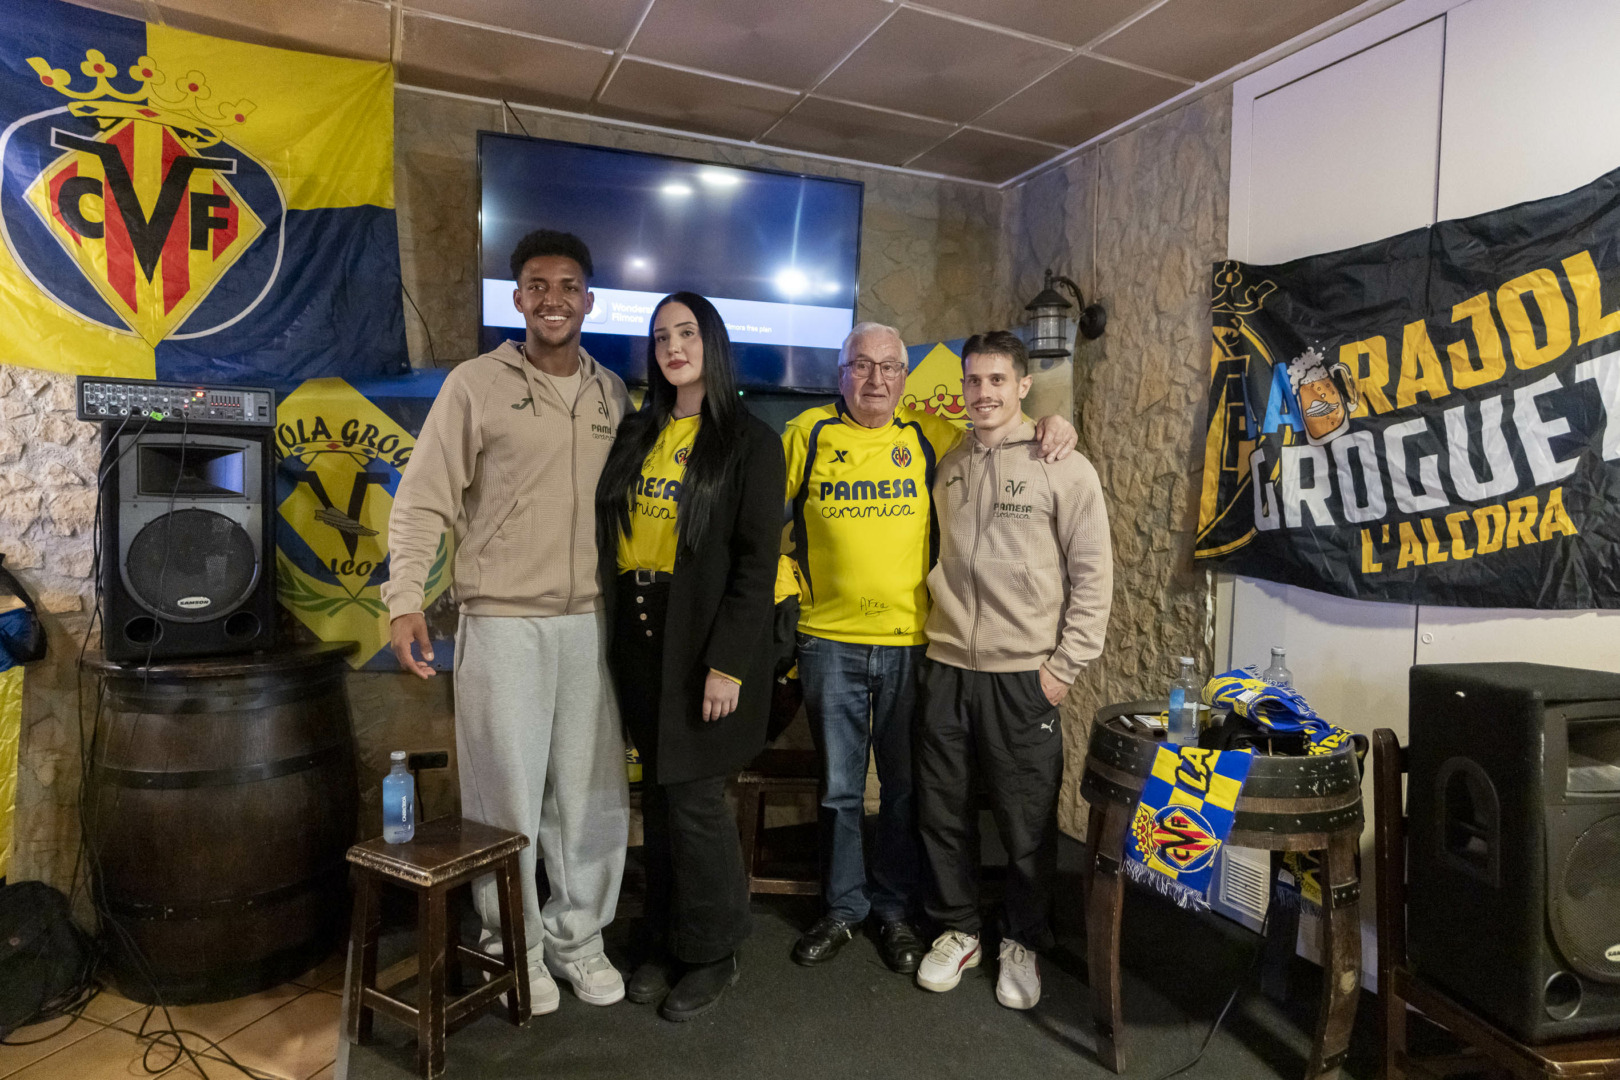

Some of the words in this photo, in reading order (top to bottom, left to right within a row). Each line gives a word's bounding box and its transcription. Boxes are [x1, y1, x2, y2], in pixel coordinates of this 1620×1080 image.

[1339, 250, 1620, 419] RAJOL
[820, 478, 918, 501] PAMESA
[821, 504, 915, 519] ceramica
[993, 502, 1032, 513] PAMESA
[1361, 487, 1578, 574] L'ALCORA
